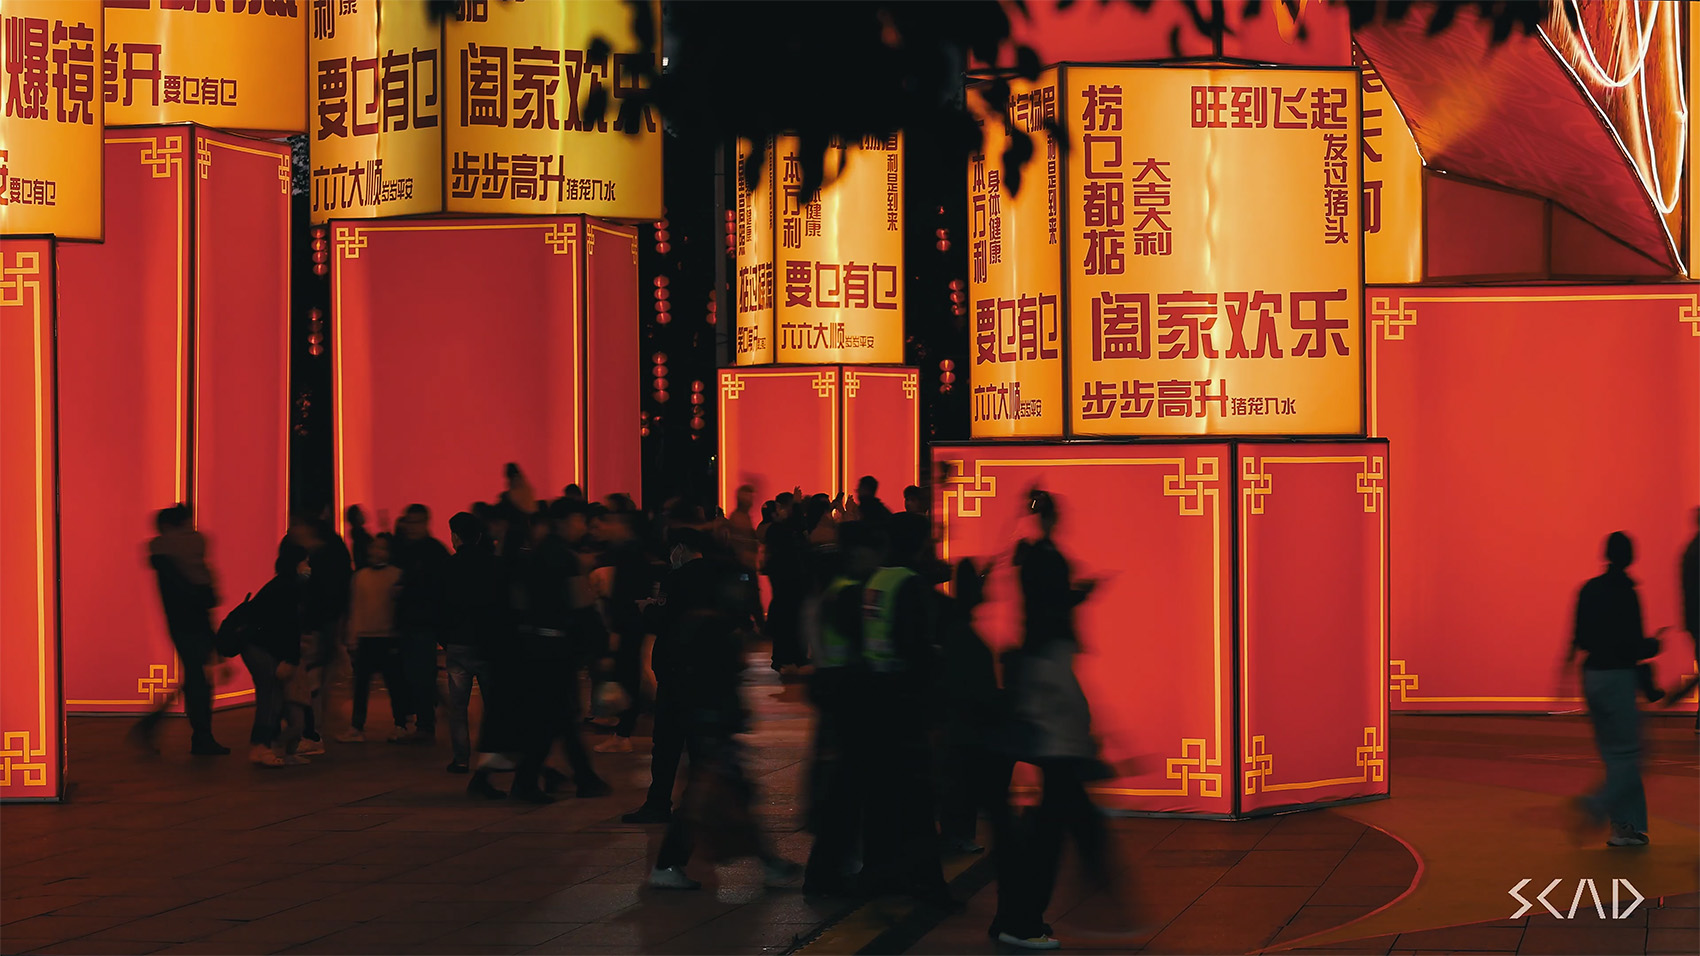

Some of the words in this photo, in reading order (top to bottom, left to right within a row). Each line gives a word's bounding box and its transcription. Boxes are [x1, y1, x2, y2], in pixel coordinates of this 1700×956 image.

[1191, 86, 1348, 129] 旺到飞起
[313, 159, 382, 212] 六六大顺
[452, 152, 565, 202] 步步高升
[1324, 134, 1349, 244] 发过猪头
[805, 188, 821, 236] 健康
[988, 170, 1001, 264] 身体健康
[1132, 158, 1172, 256] 大吉大利
[781, 322, 845, 349] 六六大顺
[1092, 289, 1350, 361] 阖家欢乐
[974, 382, 1021, 422] 六六大顺
[1082, 379, 1228, 420] 步步高升
